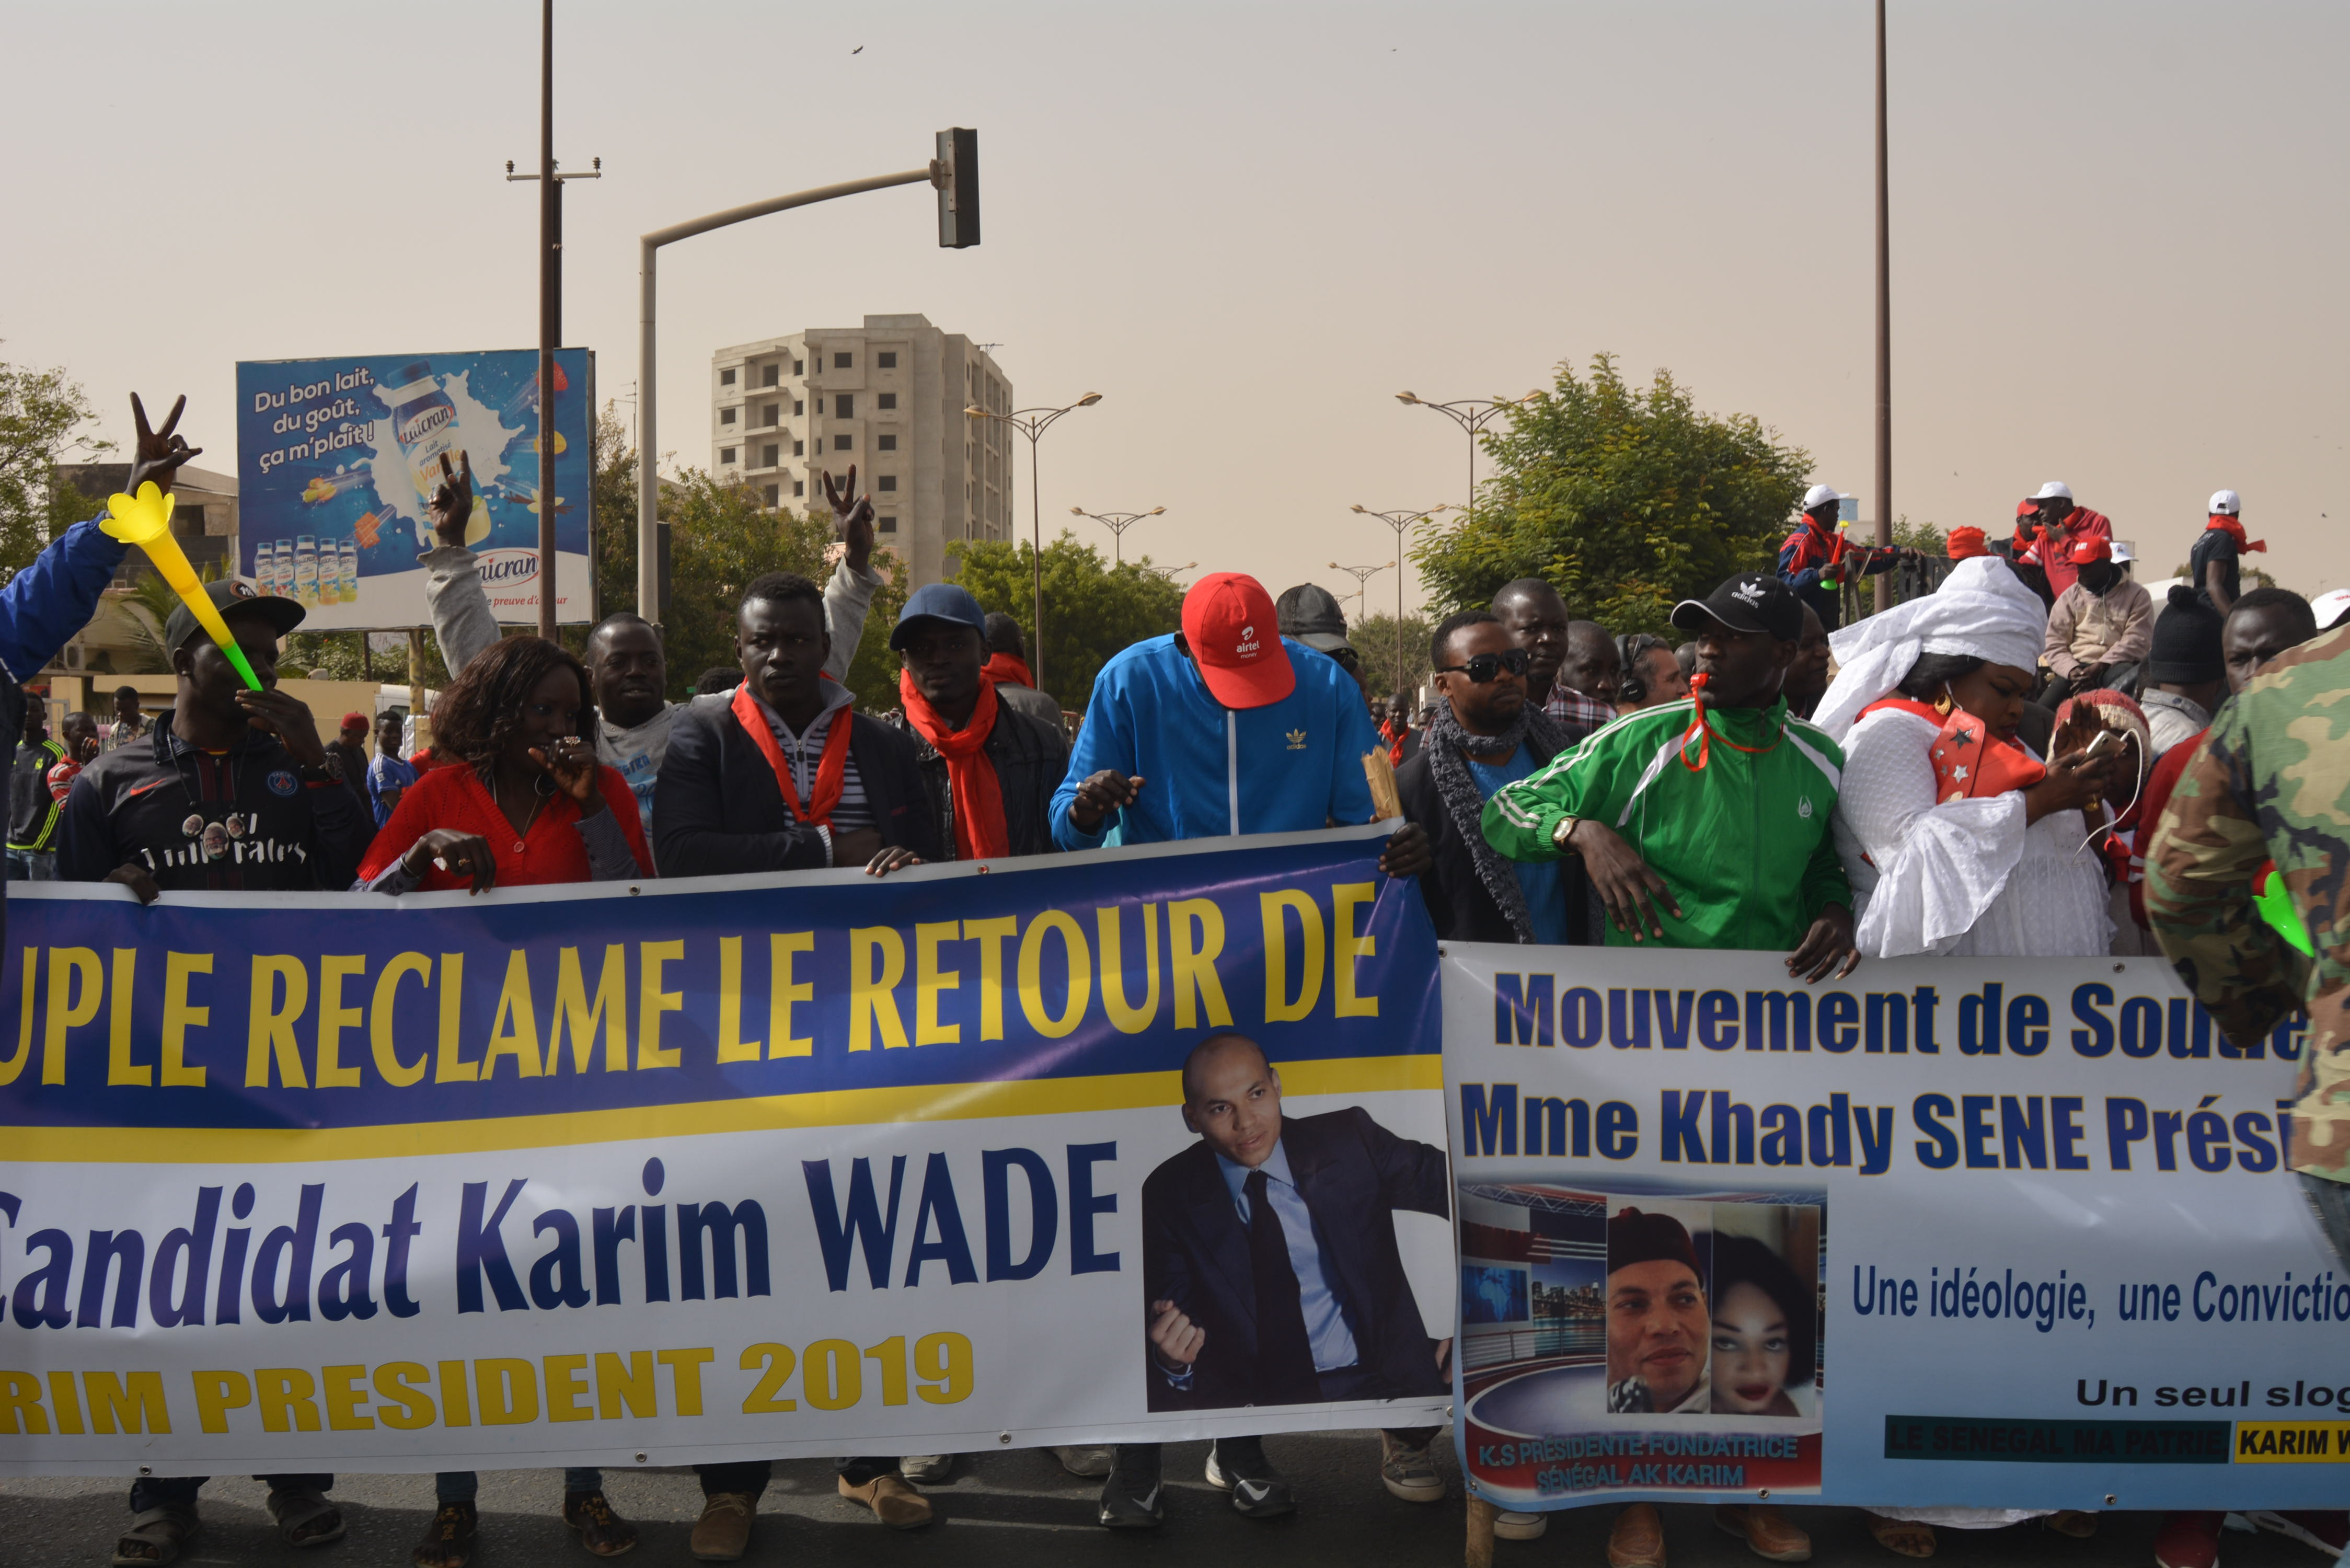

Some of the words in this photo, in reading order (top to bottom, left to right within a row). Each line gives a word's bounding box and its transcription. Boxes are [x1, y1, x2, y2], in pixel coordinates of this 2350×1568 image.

[255, 392, 285, 413] Du
[290, 381, 331, 404] bon
[336, 367, 375, 392] lait,
[273, 413, 301, 434] du
[305, 398, 361, 433] goût,
[419, 440, 452, 466] aromatisé
[425, 440, 439, 453] Lait
[259, 449, 284, 474] ça
[479, 556, 538, 583] aicran
[493, 597, 526, 607] preuve
[1731, 591, 1759, 608] adidas
[1237, 640, 1259, 653] airtel
[244, 939, 684, 1089] RECLAME
[717, 930, 814, 1065] LE
[849, 897, 1234, 1053] RETOUR
[1260, 881, 1379, 1024] DE
[1494, 972, 1940, 1054] Mouvement
[1958, 982, 2051, 1057] de
[1460, 1083, 1639, 1160] Mme
[1661, 1089, 1895, 1175] Khady
[1912, 1092, 2090, 1170] SENE
[456, 1157, 771, 1315] Karim
[801, 1140, 1120, 1293] WADE
[1853, 1265, 1918, 1317] Une
[1930, 1266, 2094, 1333] idéologie,
[2118, 1283, 2180, 1321] une
[192, 1347, 715, 1434] PRESIDENT
[739, 1331, 974, 1414] 2019
[2077, 1379, 2138, 1407] Un
[2154, 1381, 2250, 1407] seul
[1519, 1435, 1643, 1464] PRÉSIDENTE
[1649, 1435, 1798, 1458] FONDATRICE
[1890, 1424, 1923, 1451] LE
[1932, 1426, 2064, 1454] SENEGAL
[2073, 1429, 2115, 1455] MA
[2240, 1431, 2328, 1455] KARIM
[1537, 1462, 1623, 1492] SÉNÉGAL
[1628, 1463, 1662, 1485] AK
[1667, 1463, 1744, 1486] KARIM
